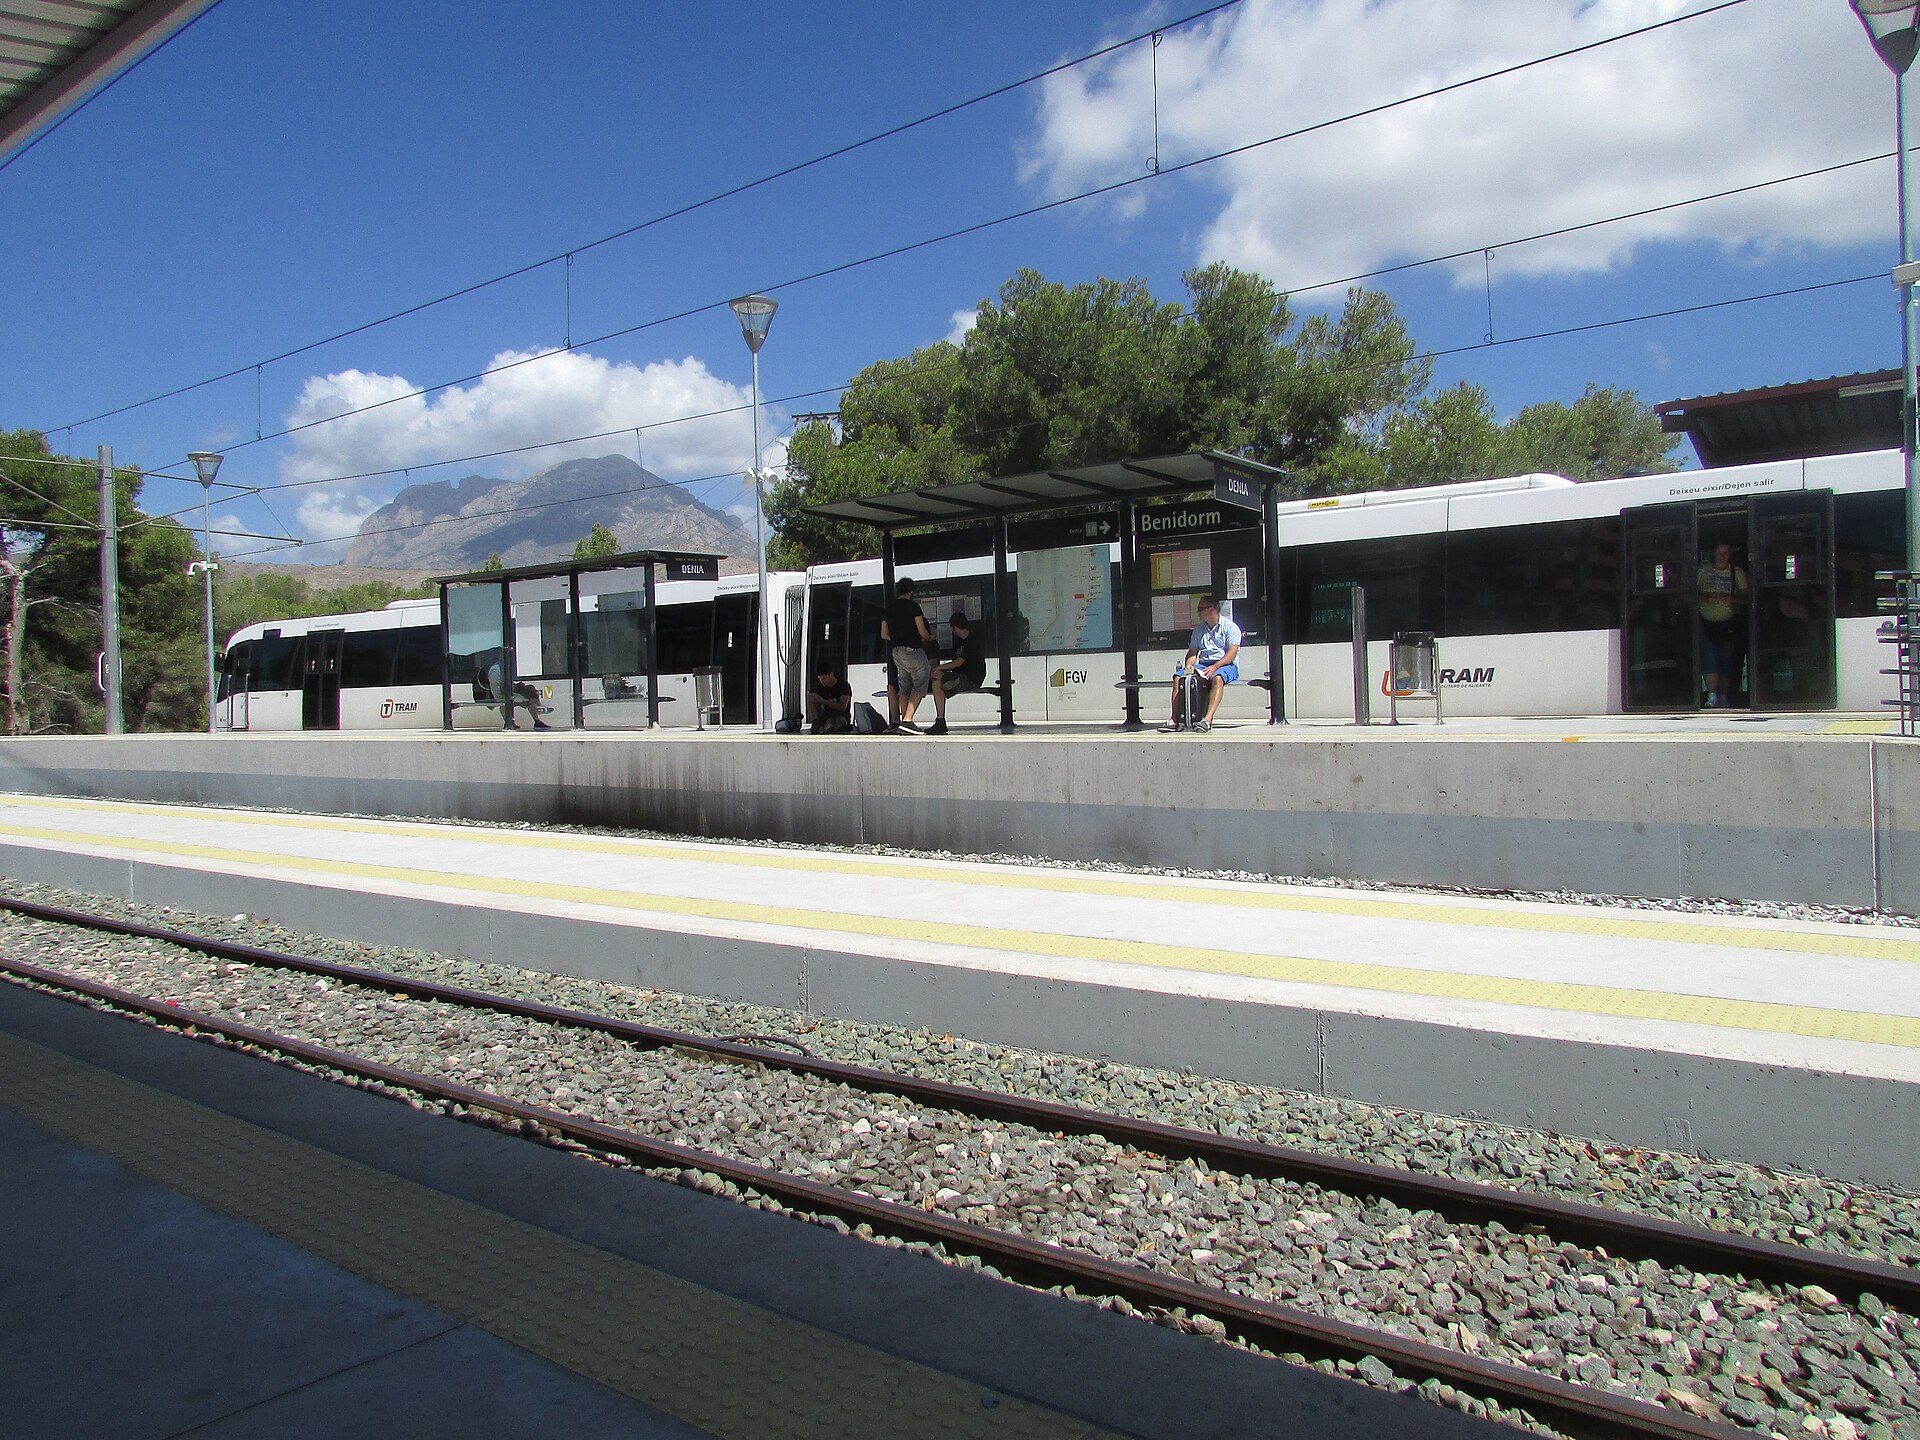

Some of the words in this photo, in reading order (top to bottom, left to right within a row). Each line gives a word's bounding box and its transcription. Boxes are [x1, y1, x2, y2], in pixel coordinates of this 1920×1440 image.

[1228, 478, 1249, 497] DENIA
[1669, 487, 1700, 496] Deixeu
[1702, 482, 1751, 493] eixir/Dejen
[1753, 479, 1775, 487] salir
[1141, 510, 1221, 532] Benidorm
[681, 564, 705, 574] DENIA
[1065, 670, 1088, 684] FGV
[1439, 667, 1495, 684] RAM
[394, 702, 418, 712] TRAM
